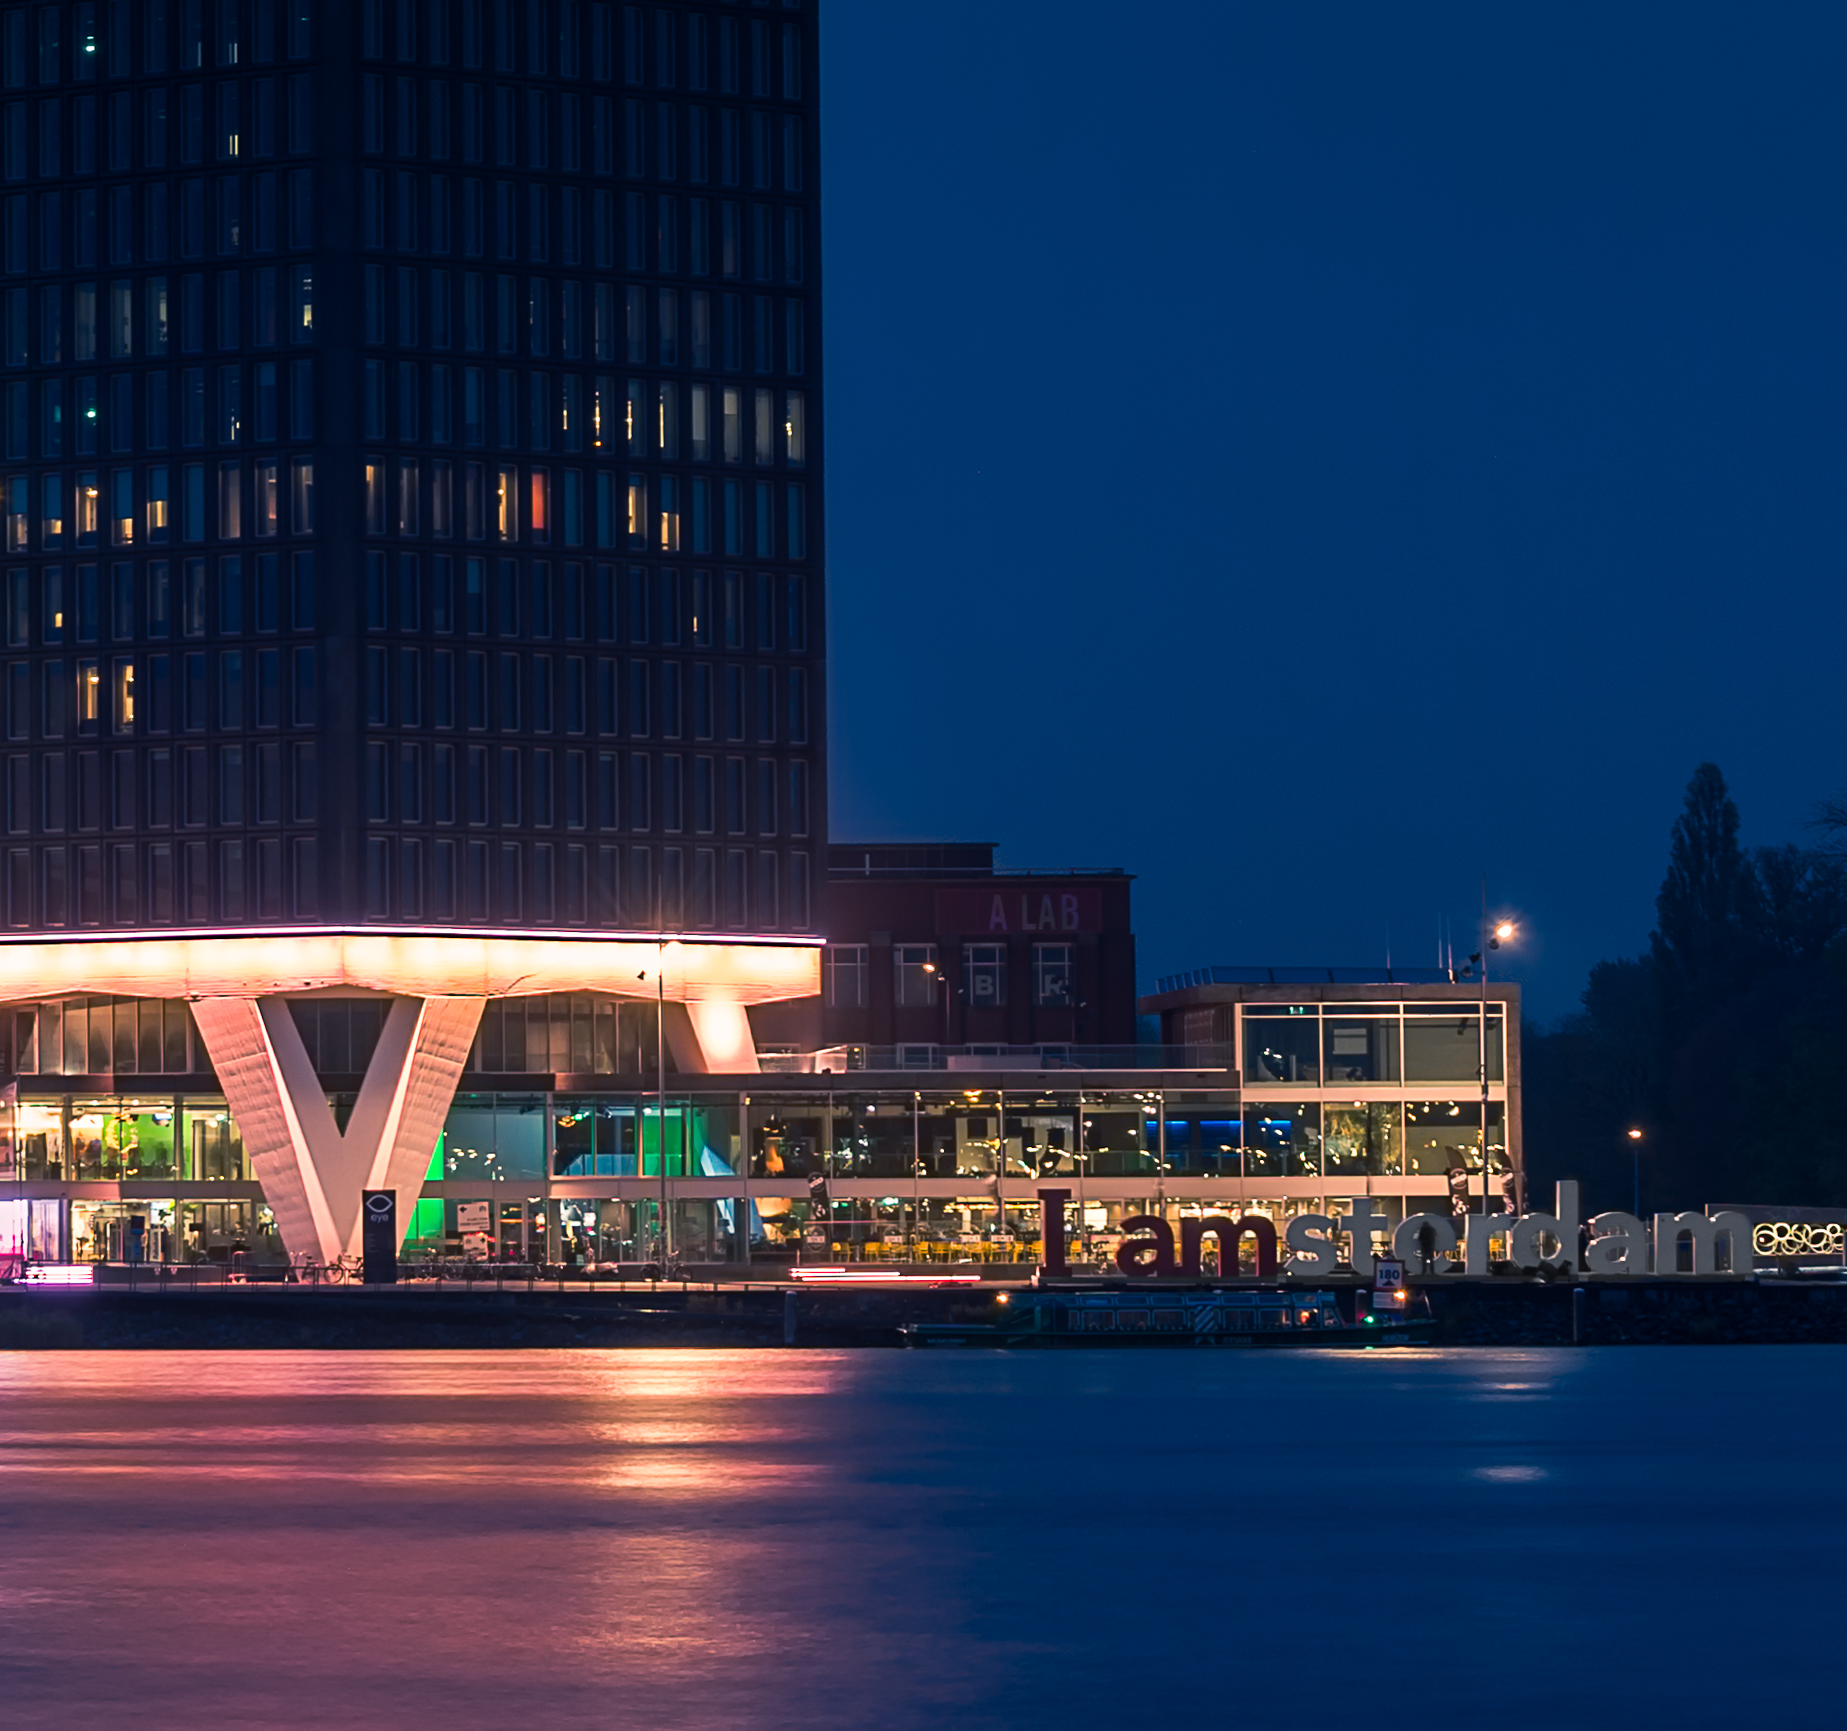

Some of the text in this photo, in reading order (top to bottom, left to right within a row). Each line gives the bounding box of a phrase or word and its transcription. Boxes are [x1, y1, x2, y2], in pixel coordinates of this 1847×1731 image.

[989, 893, 1079, 930] A LAB
[975, 975, 994, 995] B
[370, 1214, 389, 1223] eye
[1037, 1188, 1072, 1277] I
[1378, 1269, 1400, 1280] 180
